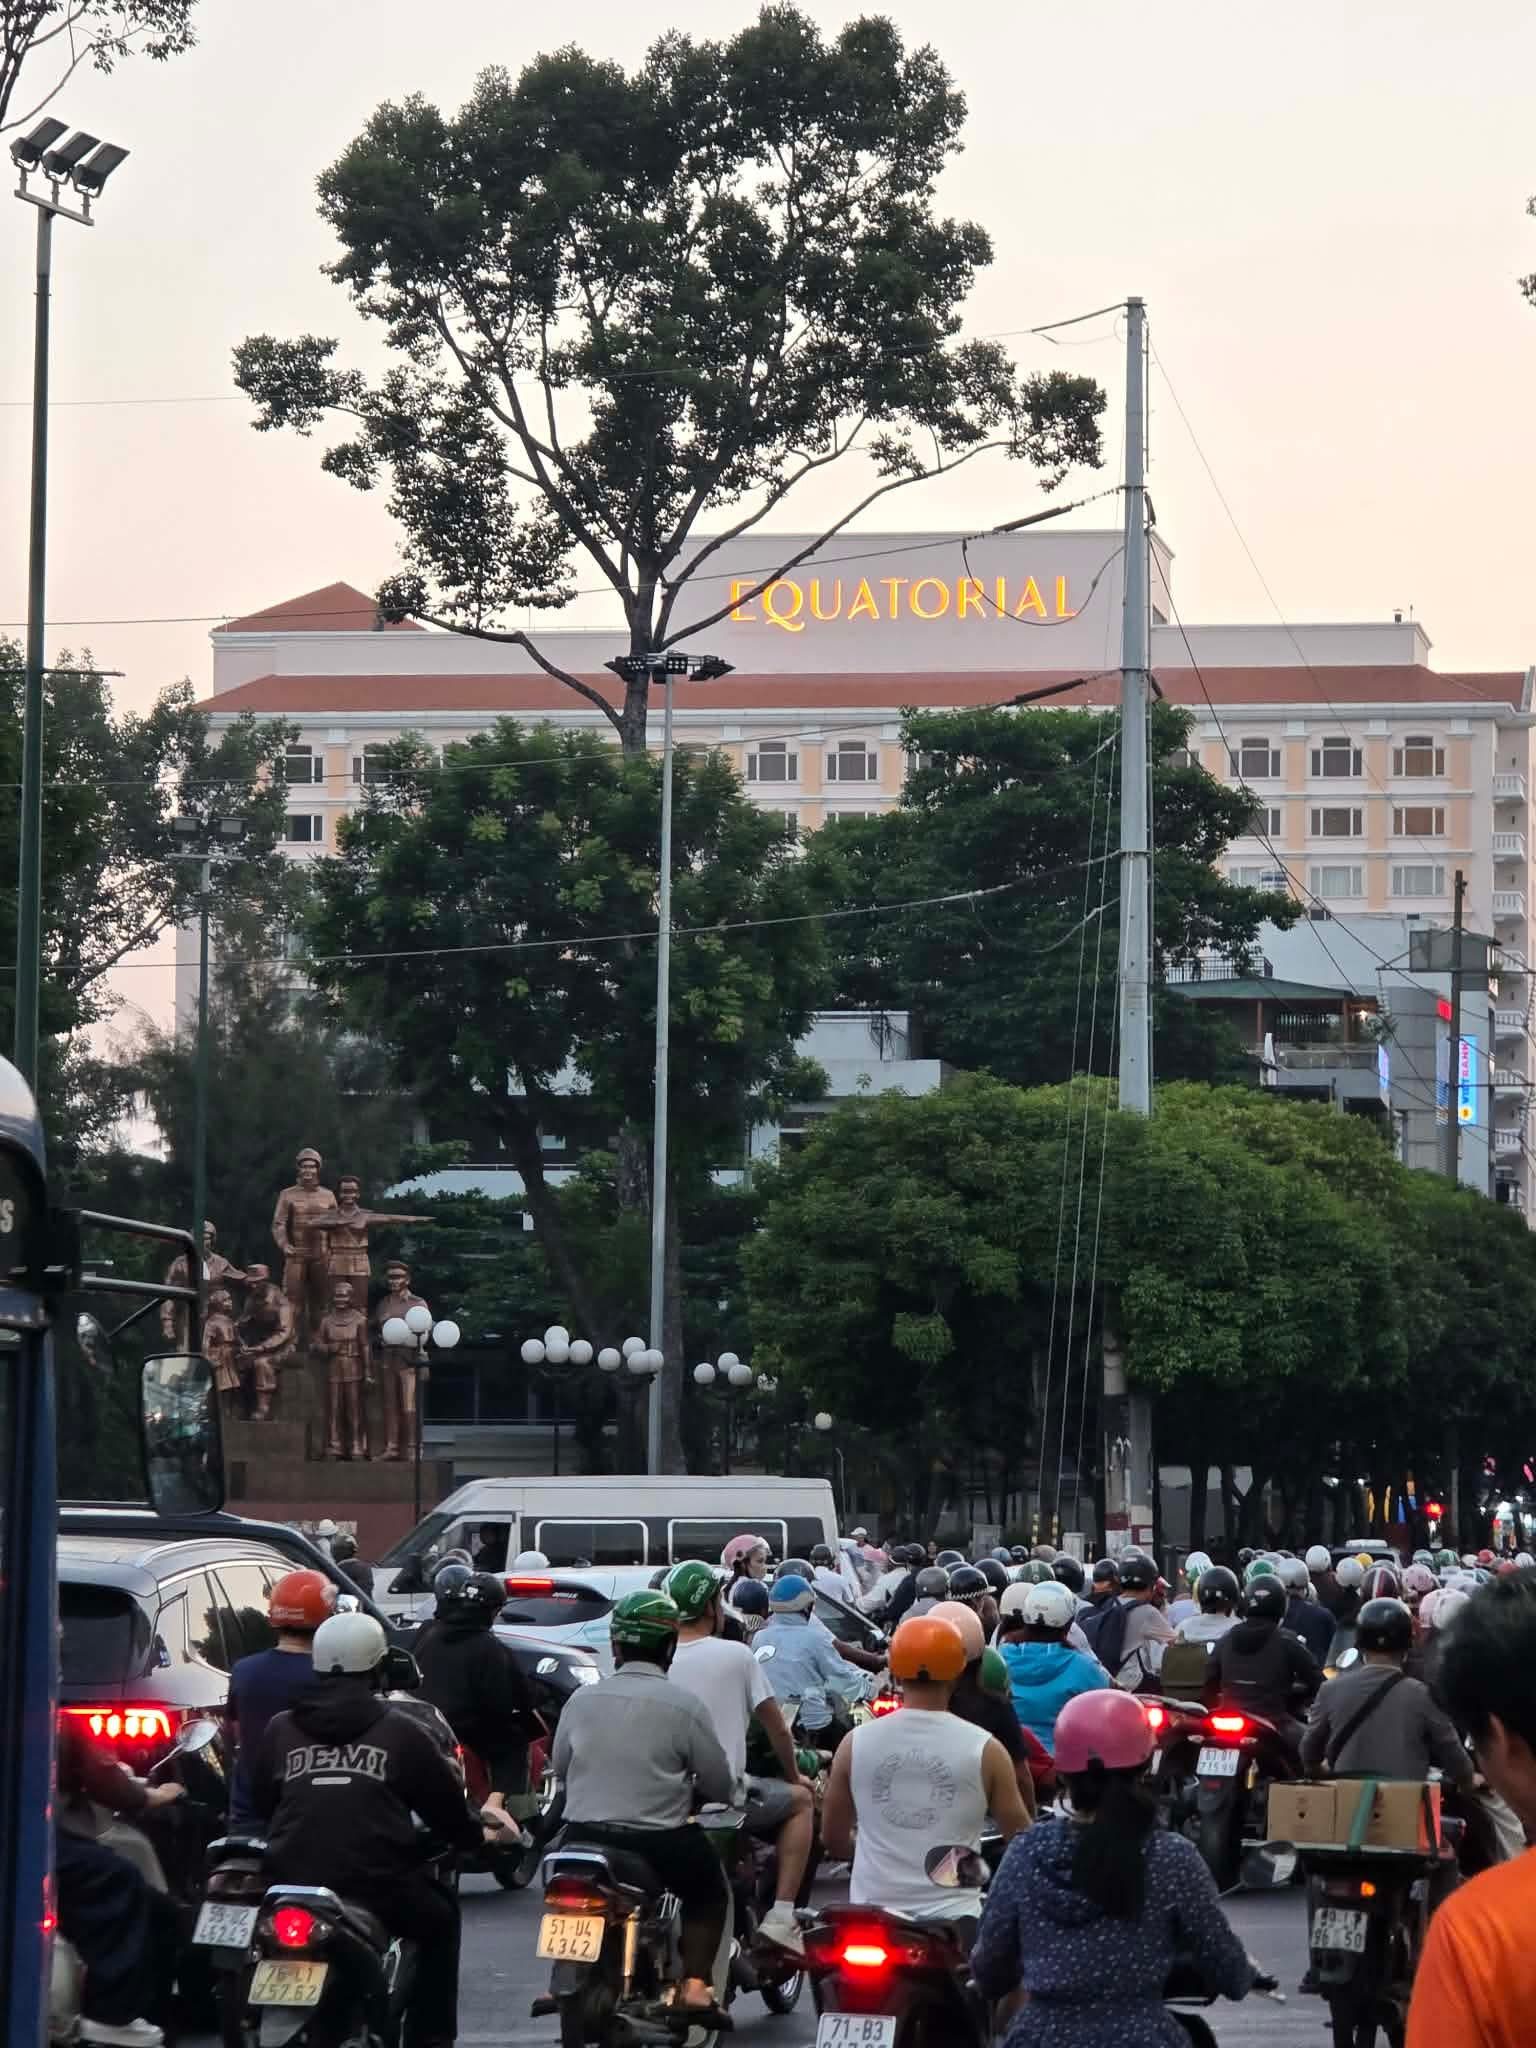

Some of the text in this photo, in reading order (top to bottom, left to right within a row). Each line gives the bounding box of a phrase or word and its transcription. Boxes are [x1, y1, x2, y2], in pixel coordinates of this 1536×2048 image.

[730, 575, 1079, 632] EQUATORIAL
[286, 1744, 388, 1781] DEMI
[831, 2018, 883, 2041] 71-B3
